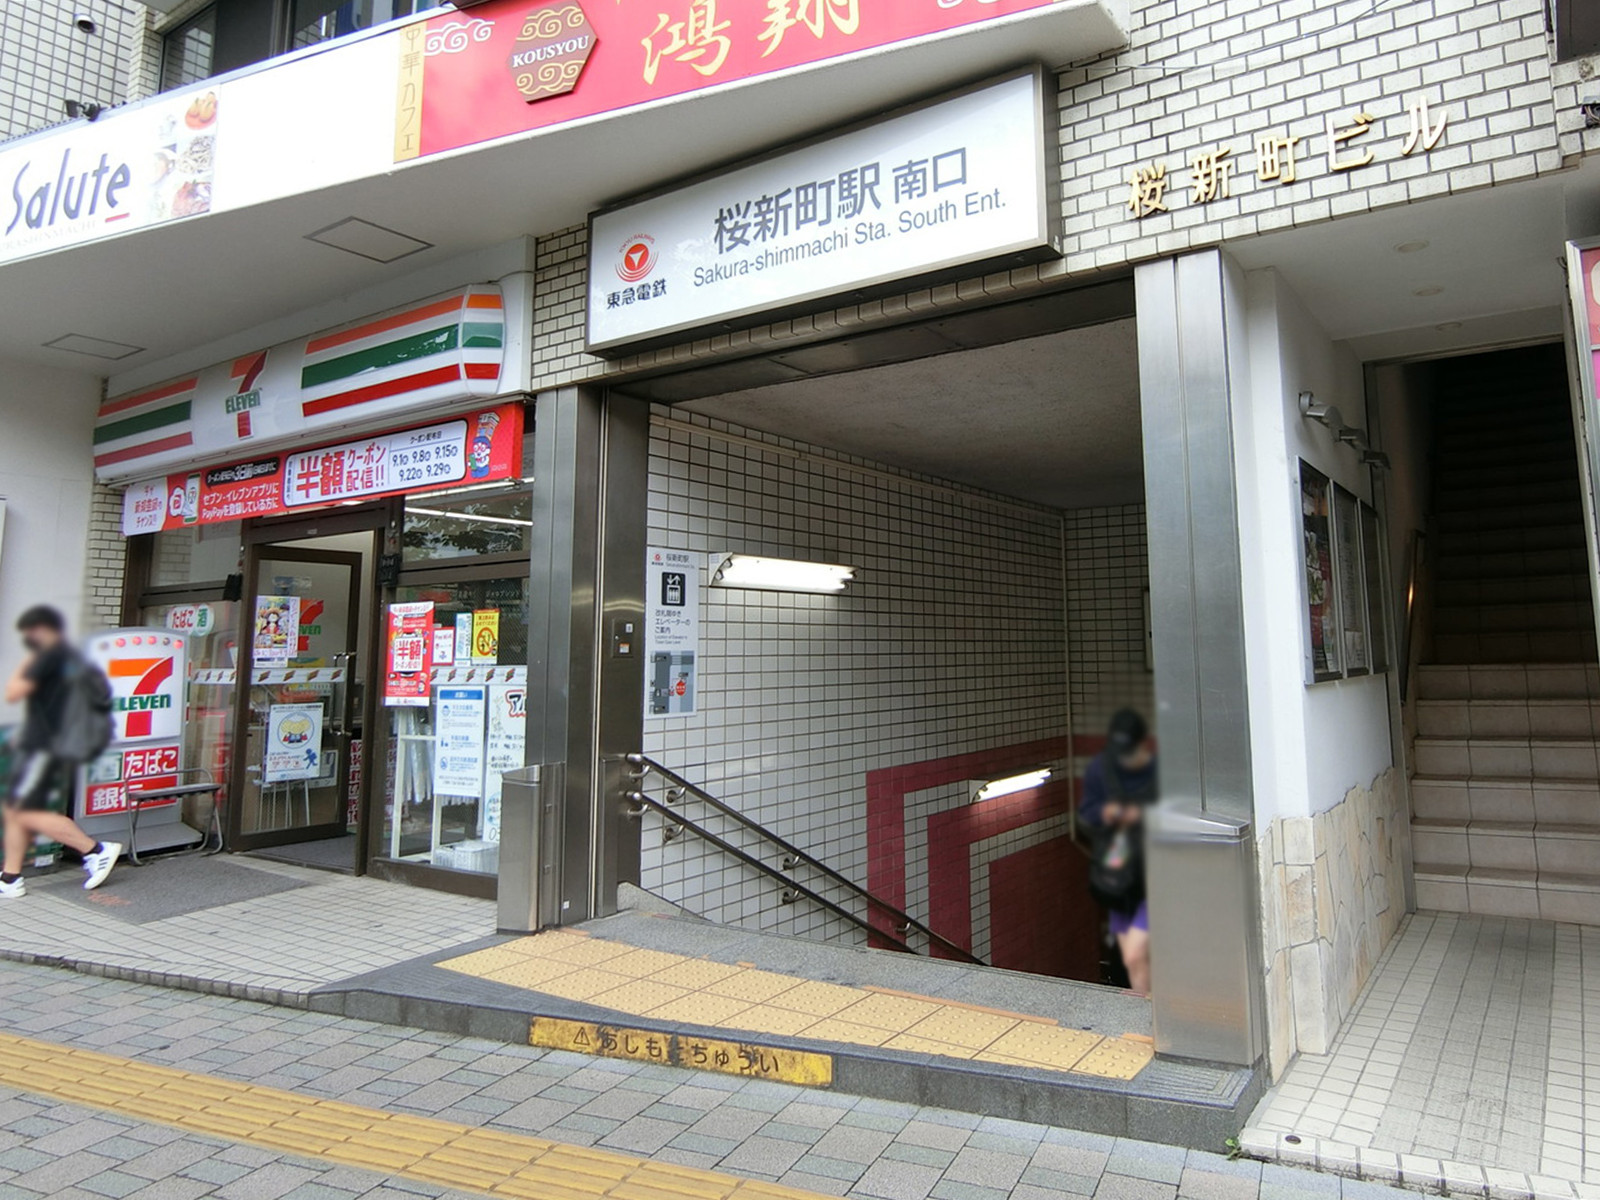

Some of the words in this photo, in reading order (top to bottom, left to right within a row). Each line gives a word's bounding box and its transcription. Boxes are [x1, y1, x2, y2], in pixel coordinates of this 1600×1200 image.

[512, 35, 590, 68] KOUSYOU
[1128, 95, 1449, 219] 桜新町ビル
[5, 148, 131, 236] Salute
[714, 162, 881, 255] 桜新町駅
[892, 147, 967, 204] 南口
[693, 227, 848, 287] Sakura-shimmachi
[854, 221, 892, 246] Sta.
[898, 199, 957, 233] South
[965, 187, 1006, 217] Ent.
[606, 278, 667, 310] 東急電鉄
[346, 442, 387, 466] クーポン
[296, 450, 346, 499] 半額
[172, 609, 194, 629] たばこ
[196, 607, 208, 628] 酒
[396, 640, 421, 660] 半額
[125, 749, 177, 778] たばこ
